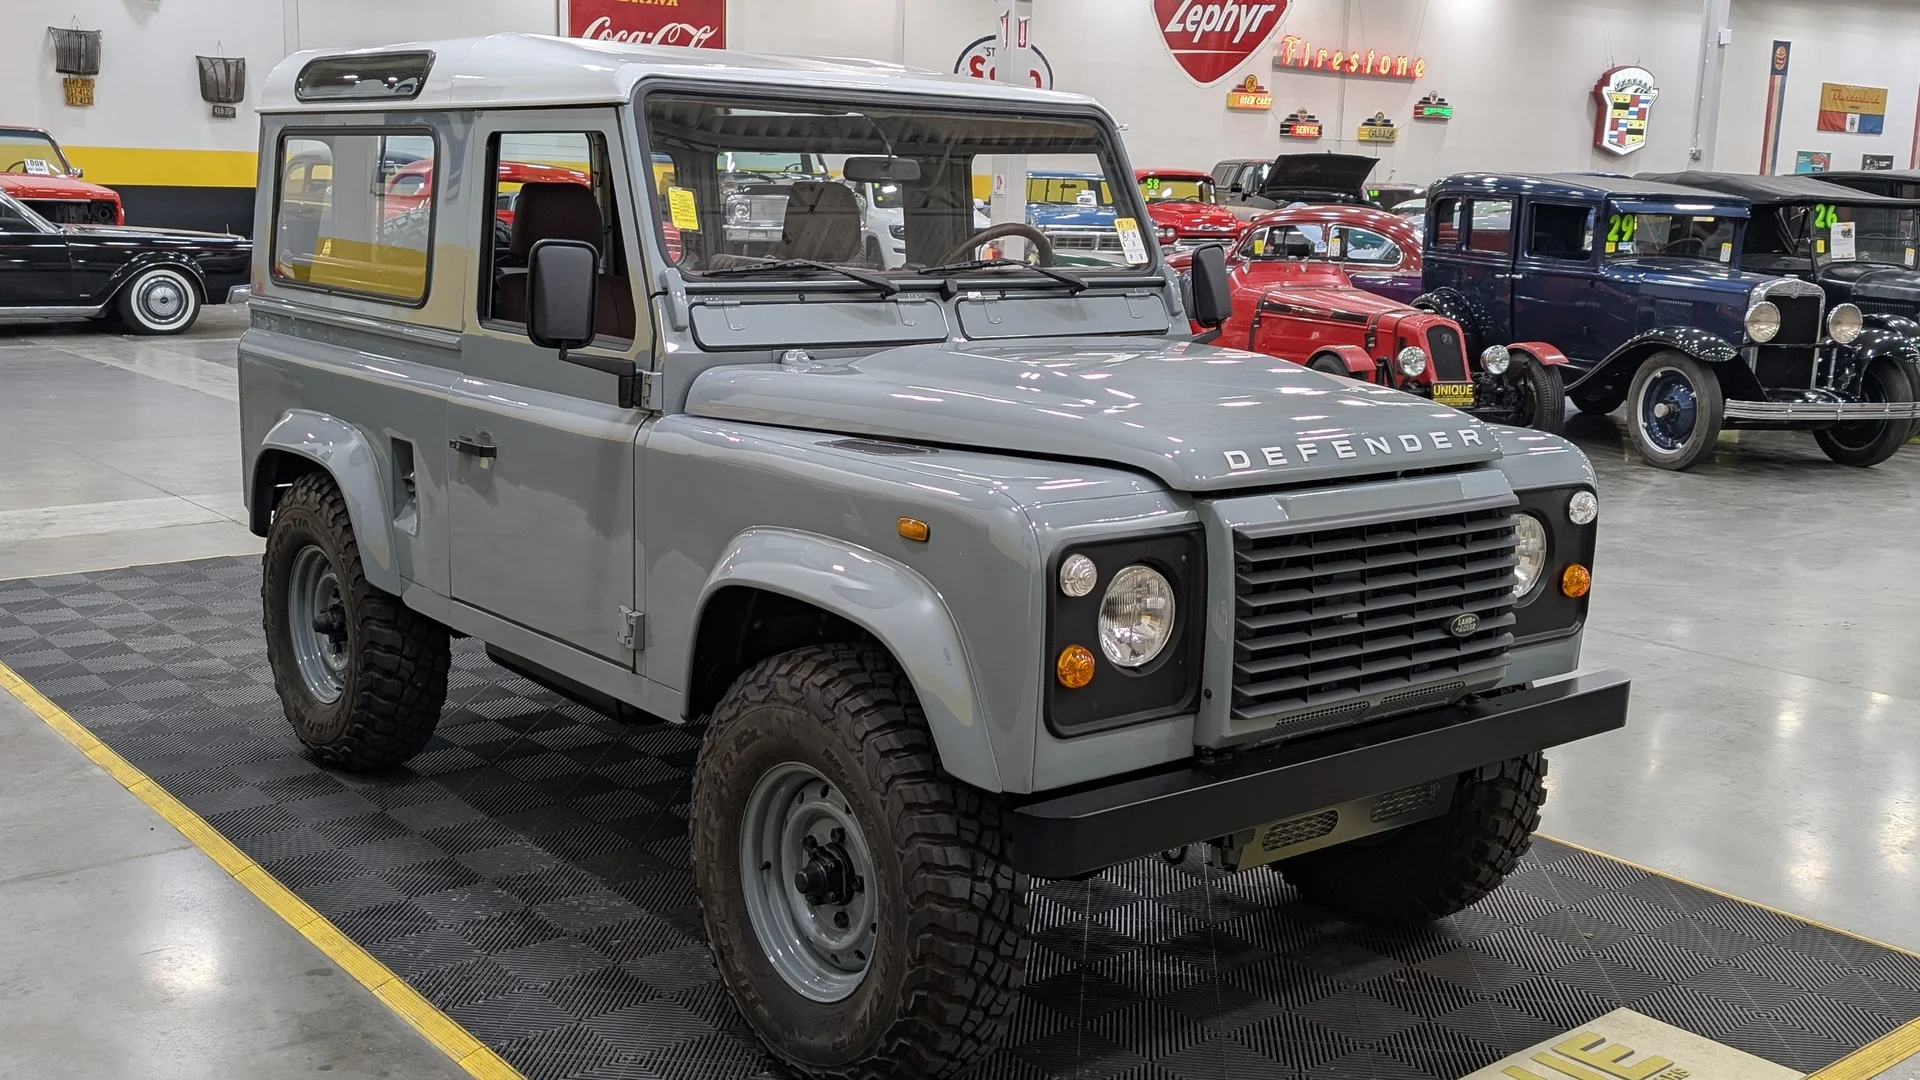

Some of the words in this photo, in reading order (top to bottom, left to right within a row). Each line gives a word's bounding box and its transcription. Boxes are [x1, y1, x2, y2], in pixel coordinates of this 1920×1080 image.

[582, 16, 718, 48] Coca-Cl
[1164, 0, 1276, 43] Zephyr
[1281, 35, 1426, 78] Firestone
[1296, 125, 1318, 134] SERVICE
[1147, 178, 1160, 189] 58
[1607, 214, 1634, 241] 29
[1815, 203, 1838, 229] 26
[1433, 384, 1474, 396] UNIQUE
[1223, 428, 1483, 470] DEFENDER
